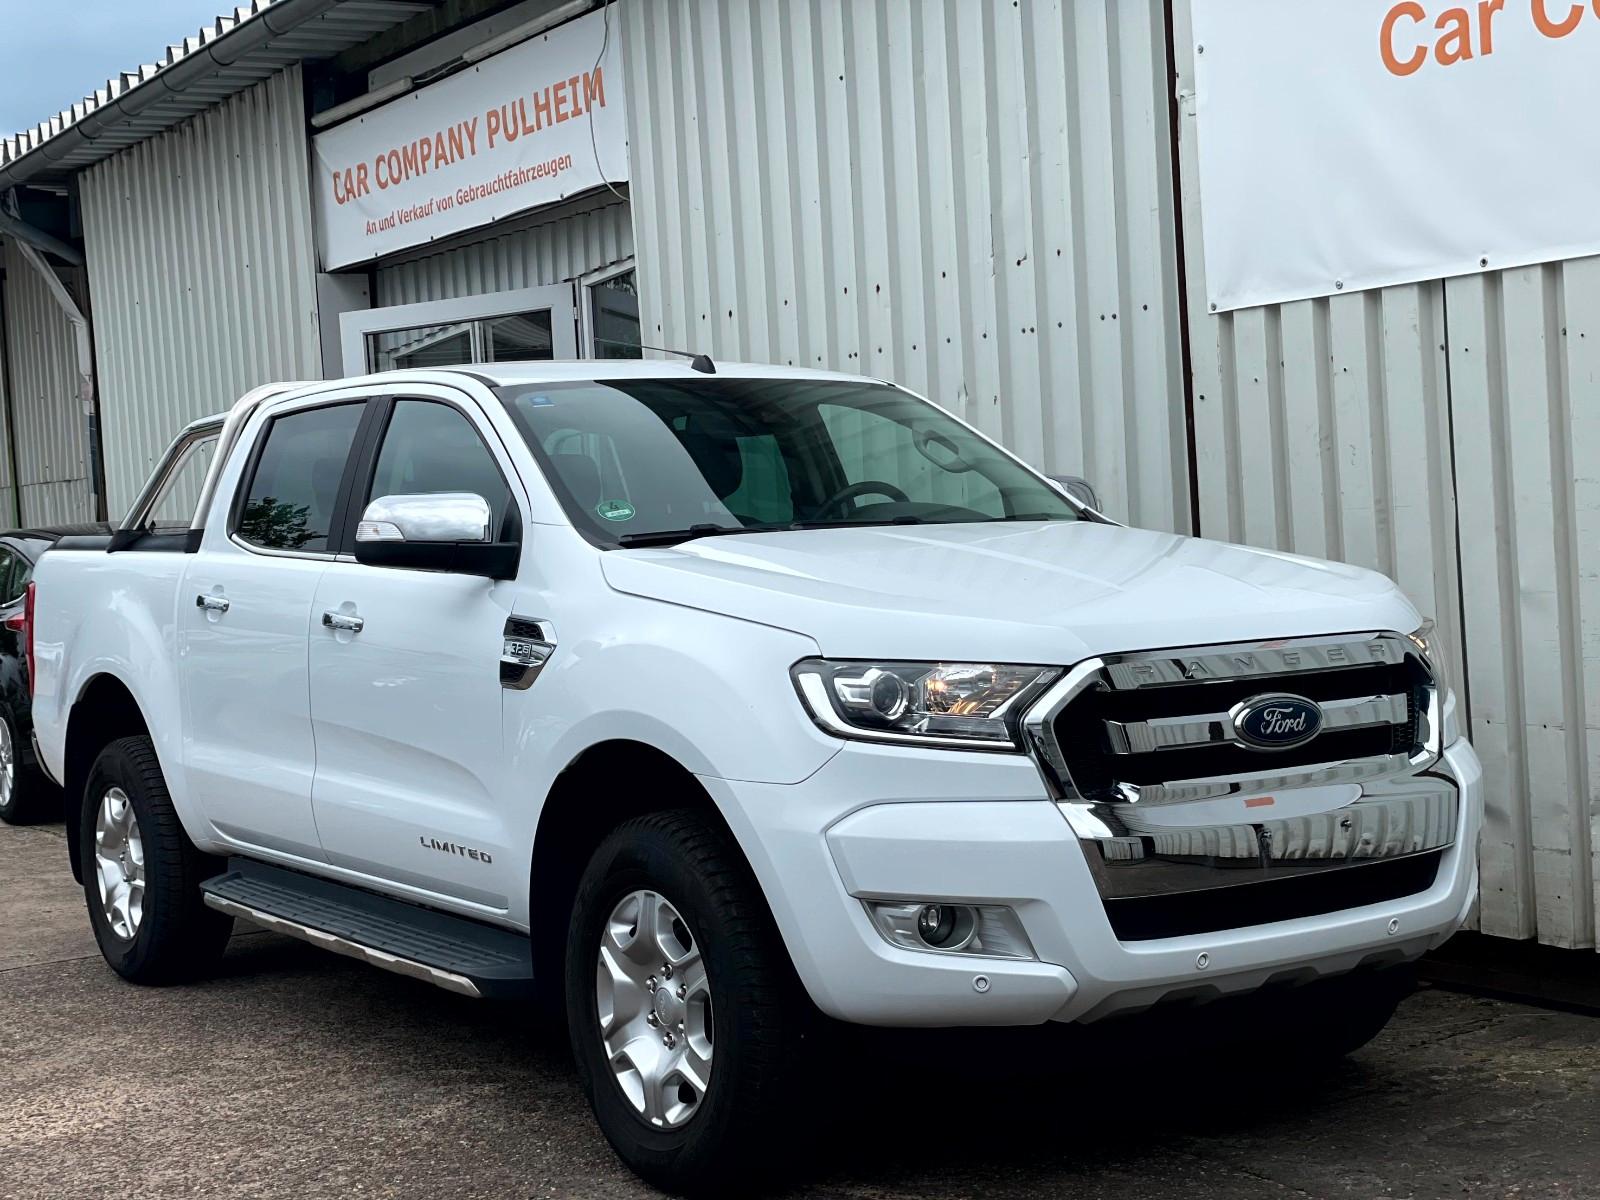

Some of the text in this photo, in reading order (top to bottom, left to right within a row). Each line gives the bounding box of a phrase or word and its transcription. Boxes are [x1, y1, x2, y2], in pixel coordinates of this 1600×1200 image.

[1379, 0, 1503, 77] Car
[333, 66, 606, 206] CAR COMPANY PULHEIM
[365, 153, 572, 236] An und Verkauf von Gebrauchtfahrzeugen
[1132, 643, 1386, 684] RANGER
[1261, 706, 1307, 735] Ford
[420, 836, 492, 864] LIMITED
